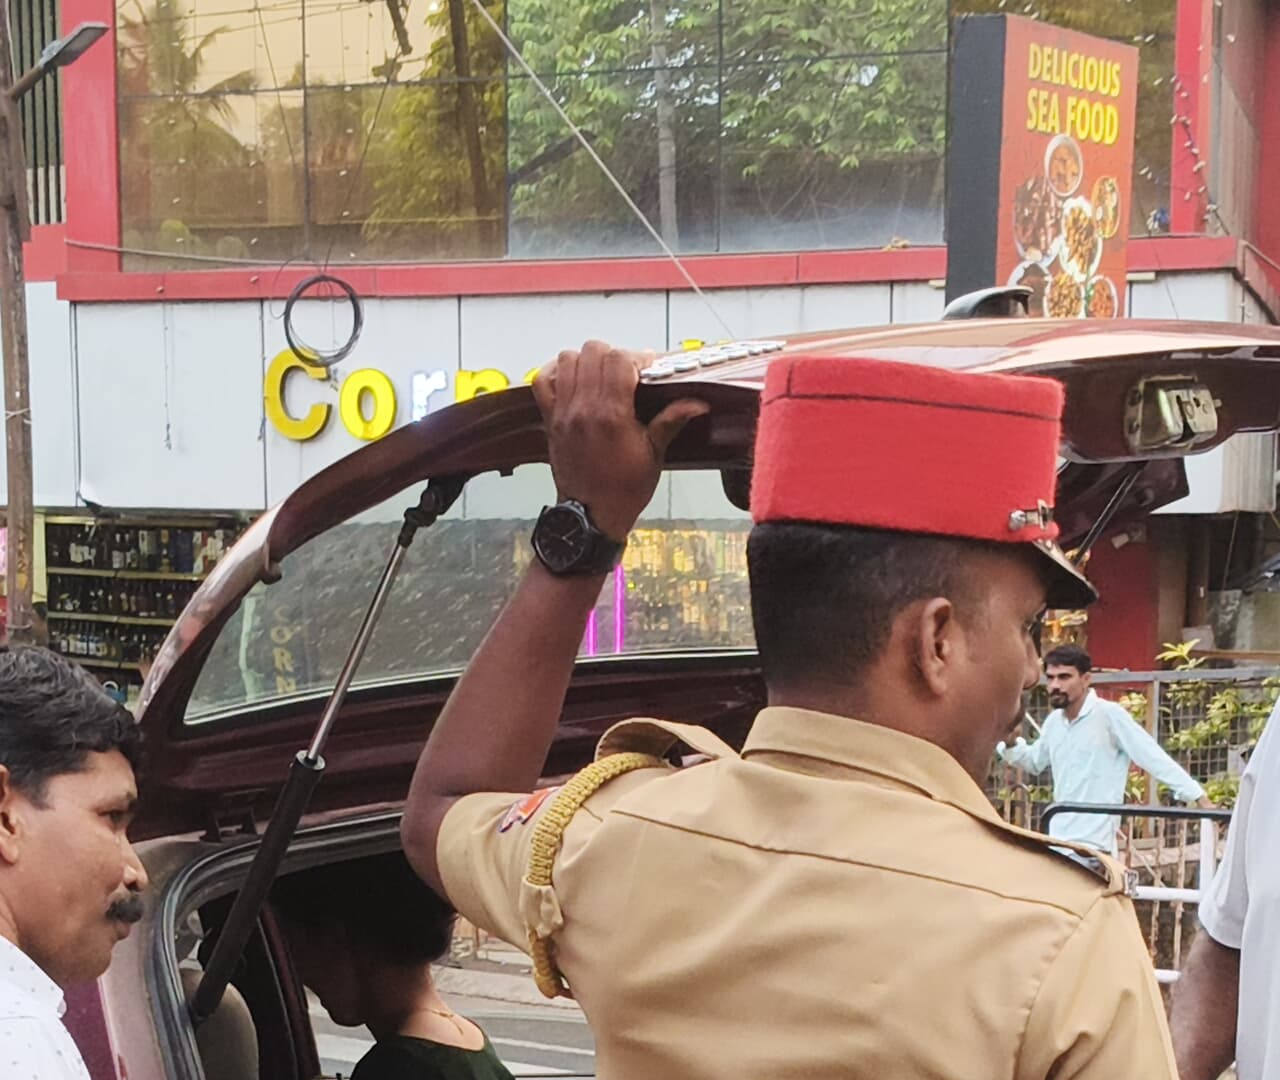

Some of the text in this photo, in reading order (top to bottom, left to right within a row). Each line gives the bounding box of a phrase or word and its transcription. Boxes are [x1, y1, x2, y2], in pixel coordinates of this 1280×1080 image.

[1028, 42, 1121, 98] DELICIOUS
[1026, 87, 1119, 145] SEA FOOD
